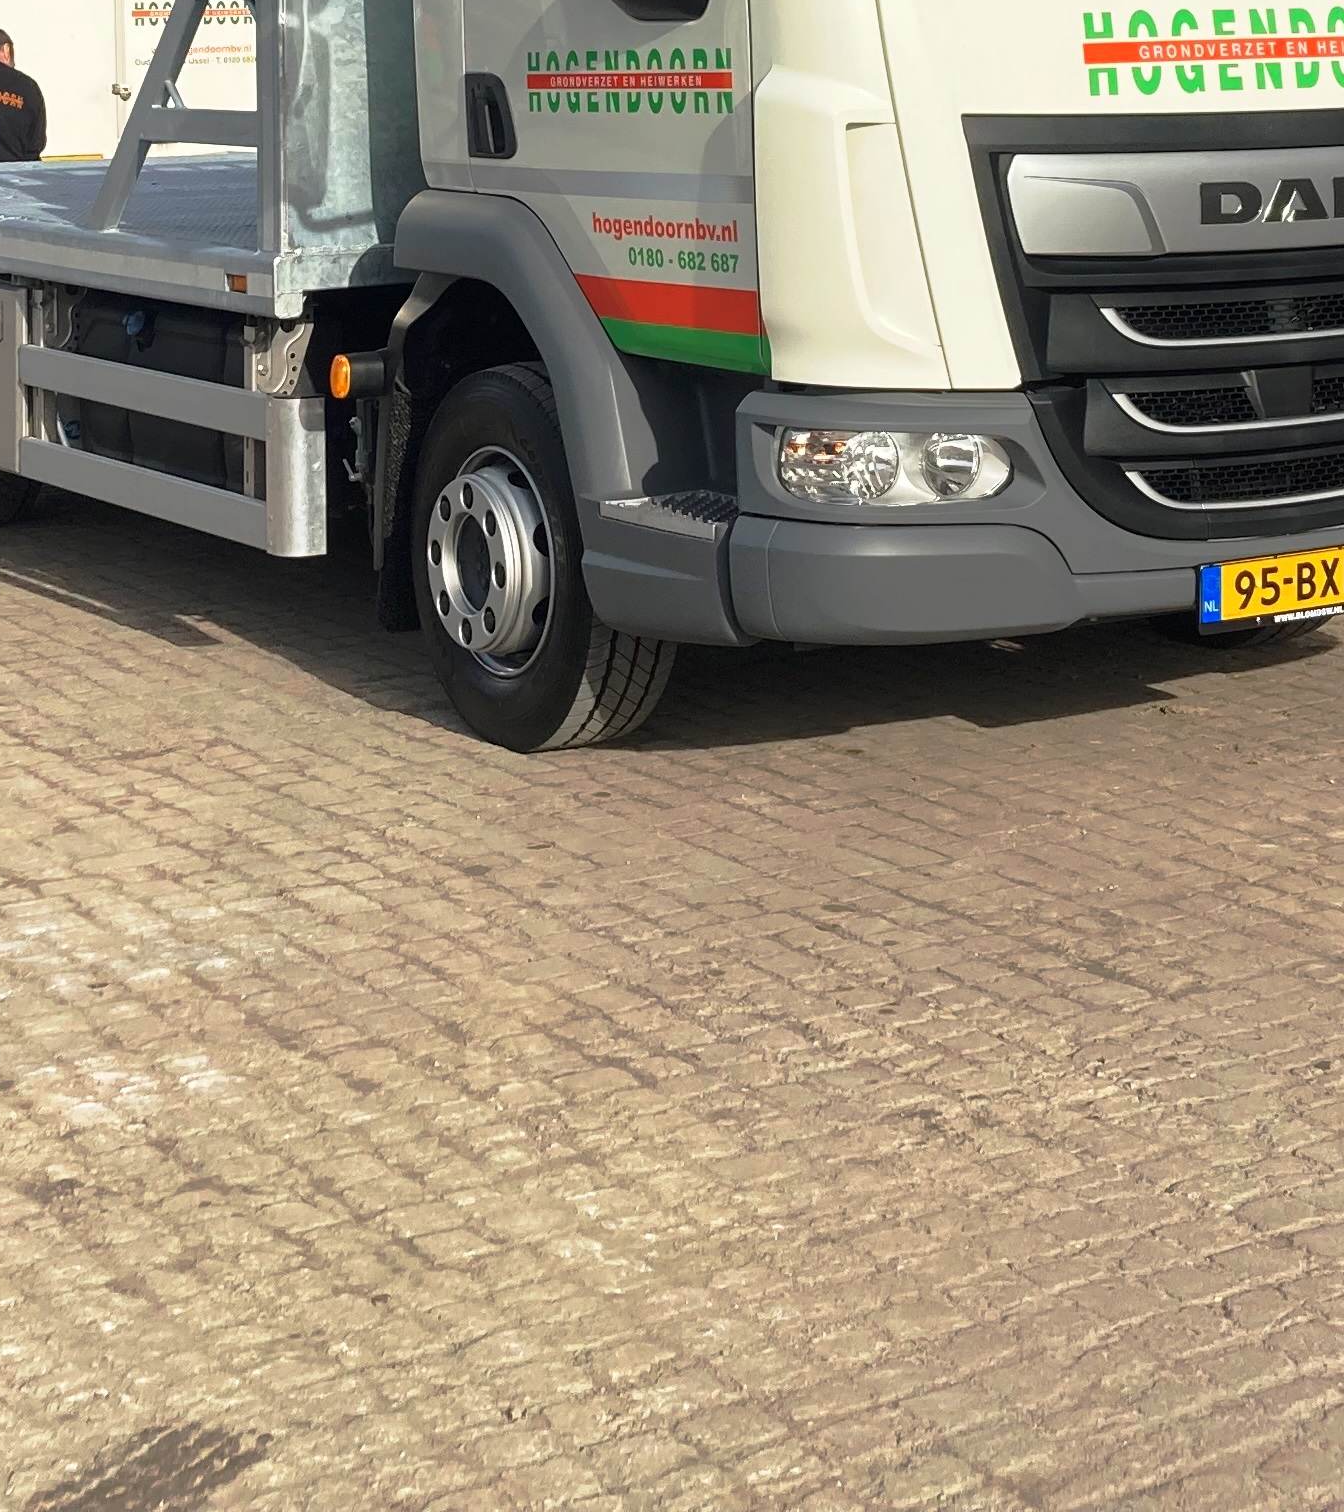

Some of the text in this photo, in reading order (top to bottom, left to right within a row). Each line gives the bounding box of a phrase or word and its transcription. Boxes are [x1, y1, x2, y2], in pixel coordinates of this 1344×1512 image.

[1139, 41, 1277, 60] GRONDVERZET
[1285, 41, 1308, 56] EN
[527, 47, 734, 114] HOGENDOORN
[550, 75, 702, 88] GRONDVERZET EN HEIWERKEN
[592, 212, 739, 243] hogendoornbv.nl
[628, 247, 664, 268] 0180
[678, 250, 706, 271] 682
[710, 252, 739, 273] 687
[1203, 599, 1219, 614] NL
